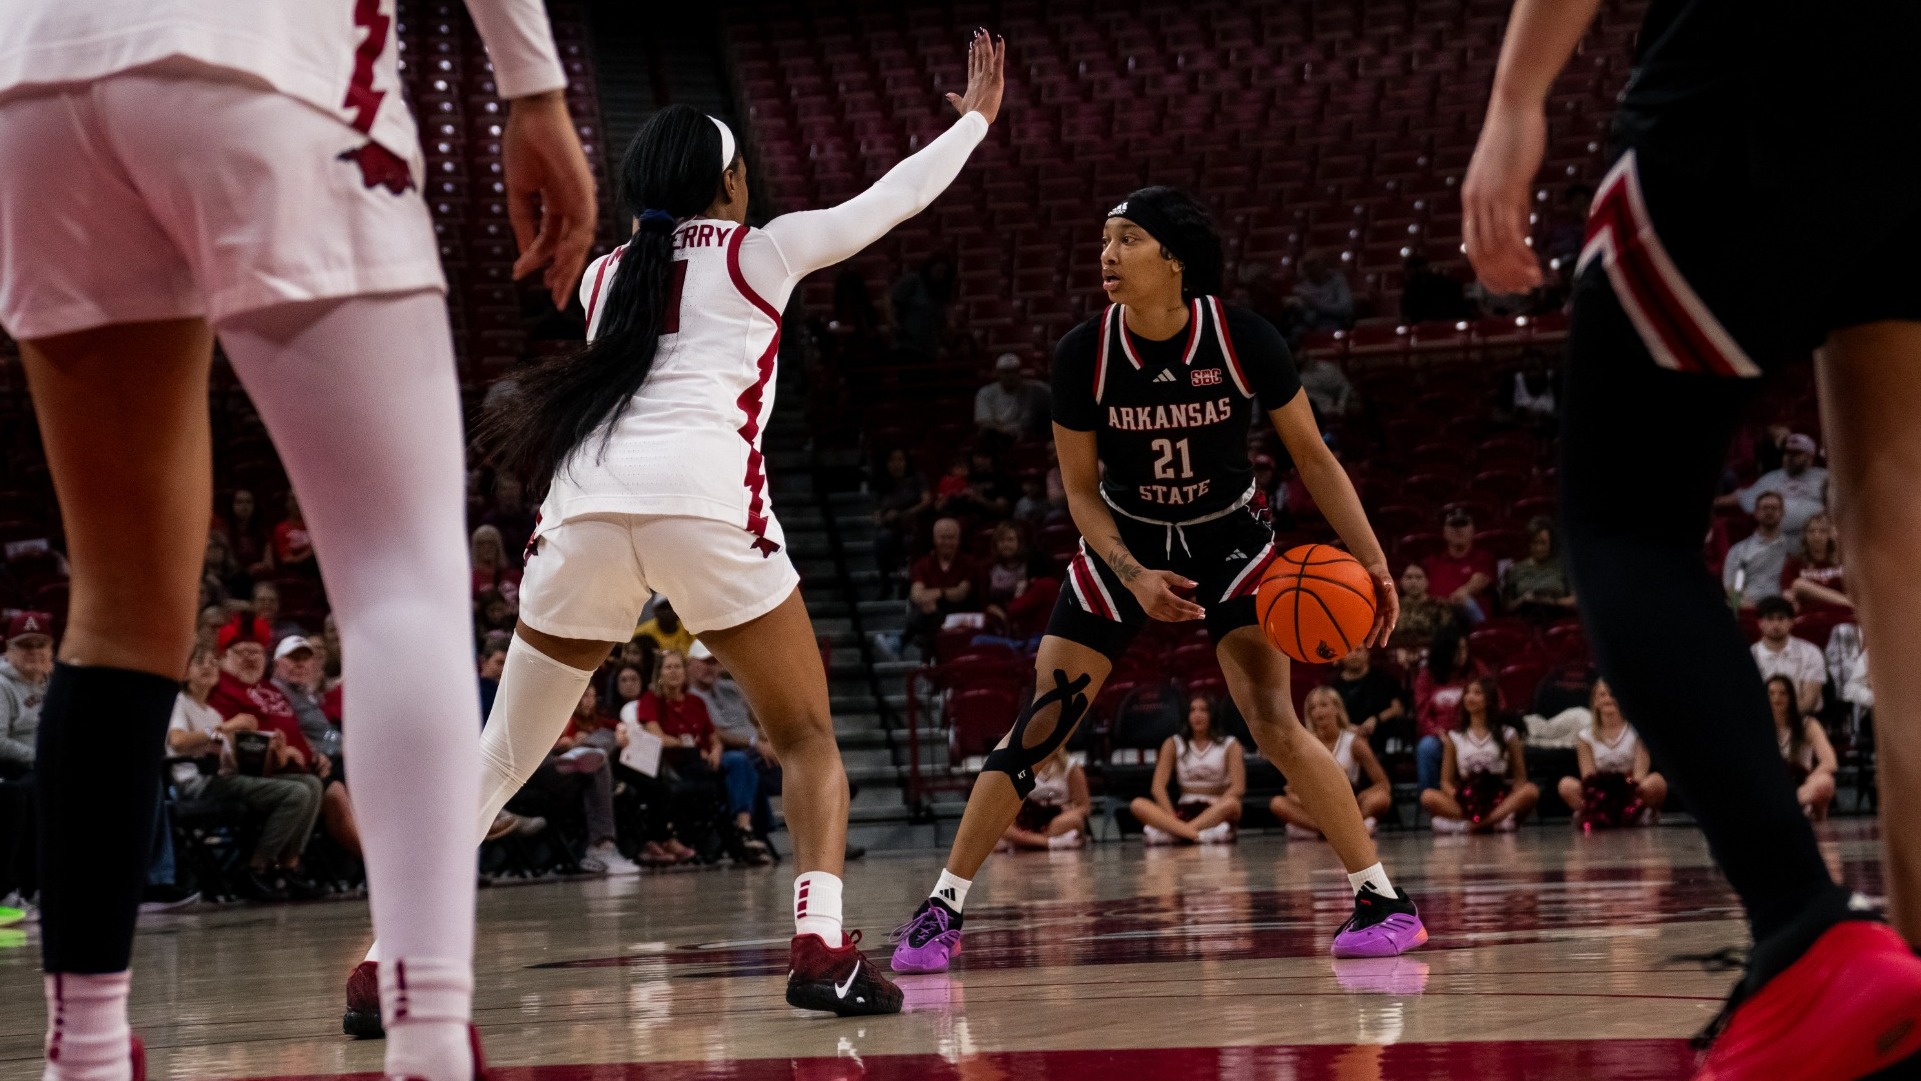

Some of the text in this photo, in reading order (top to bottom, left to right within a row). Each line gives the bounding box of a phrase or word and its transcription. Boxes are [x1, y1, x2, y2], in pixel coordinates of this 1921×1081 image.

[1190, 368, 1222, 387] SBC
[1108, 397, 1231, 431] ARKANSAS
[1151, 437, 1194, 480] 21
[1138, 479, 1211, 505] STATE
[23, 615, 40, 631] A
[1017, 769, 1027, 780] KT
